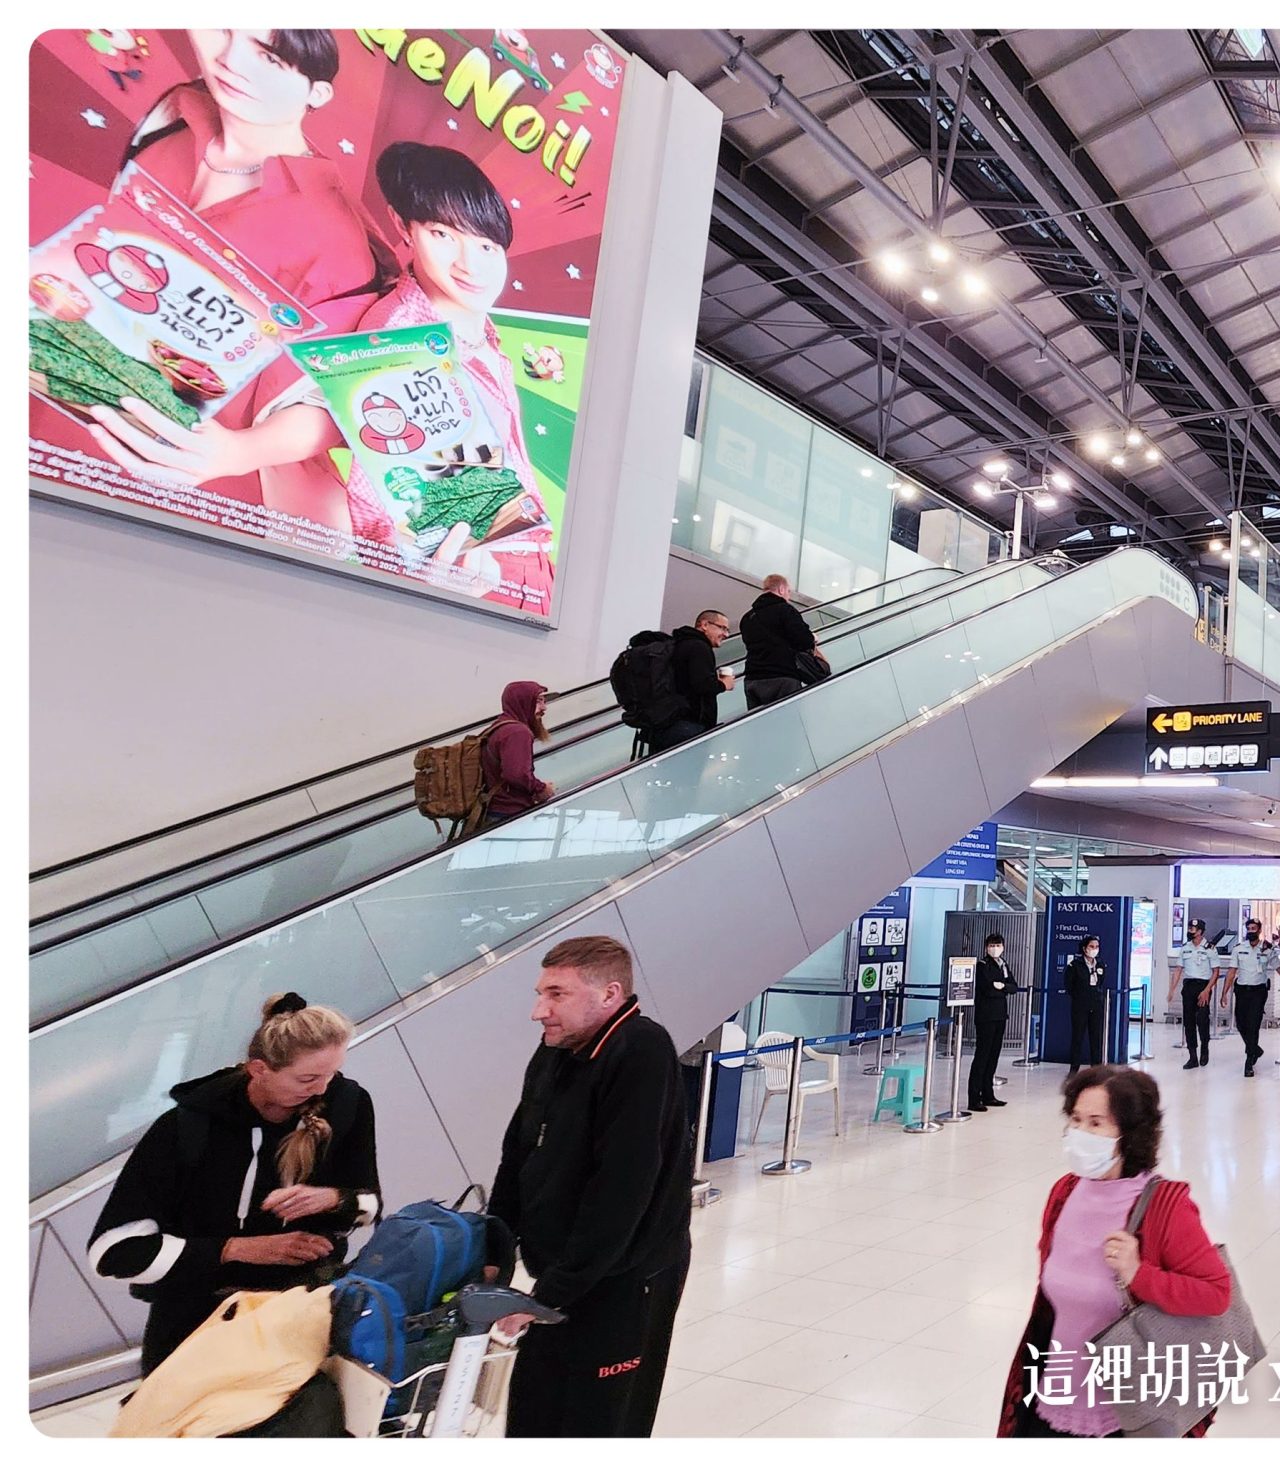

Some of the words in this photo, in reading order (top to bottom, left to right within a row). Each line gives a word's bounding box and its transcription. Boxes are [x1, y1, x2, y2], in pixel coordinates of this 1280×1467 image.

[1193, 713, 1236, 725] PRIORITY
[1237, 712, 1262, 723] LANE
[1057, 902, 1079, 912] FAST
[1080, 903, 1113, 913] TRACK
[599, 1356, 641, 1378] BOSS
